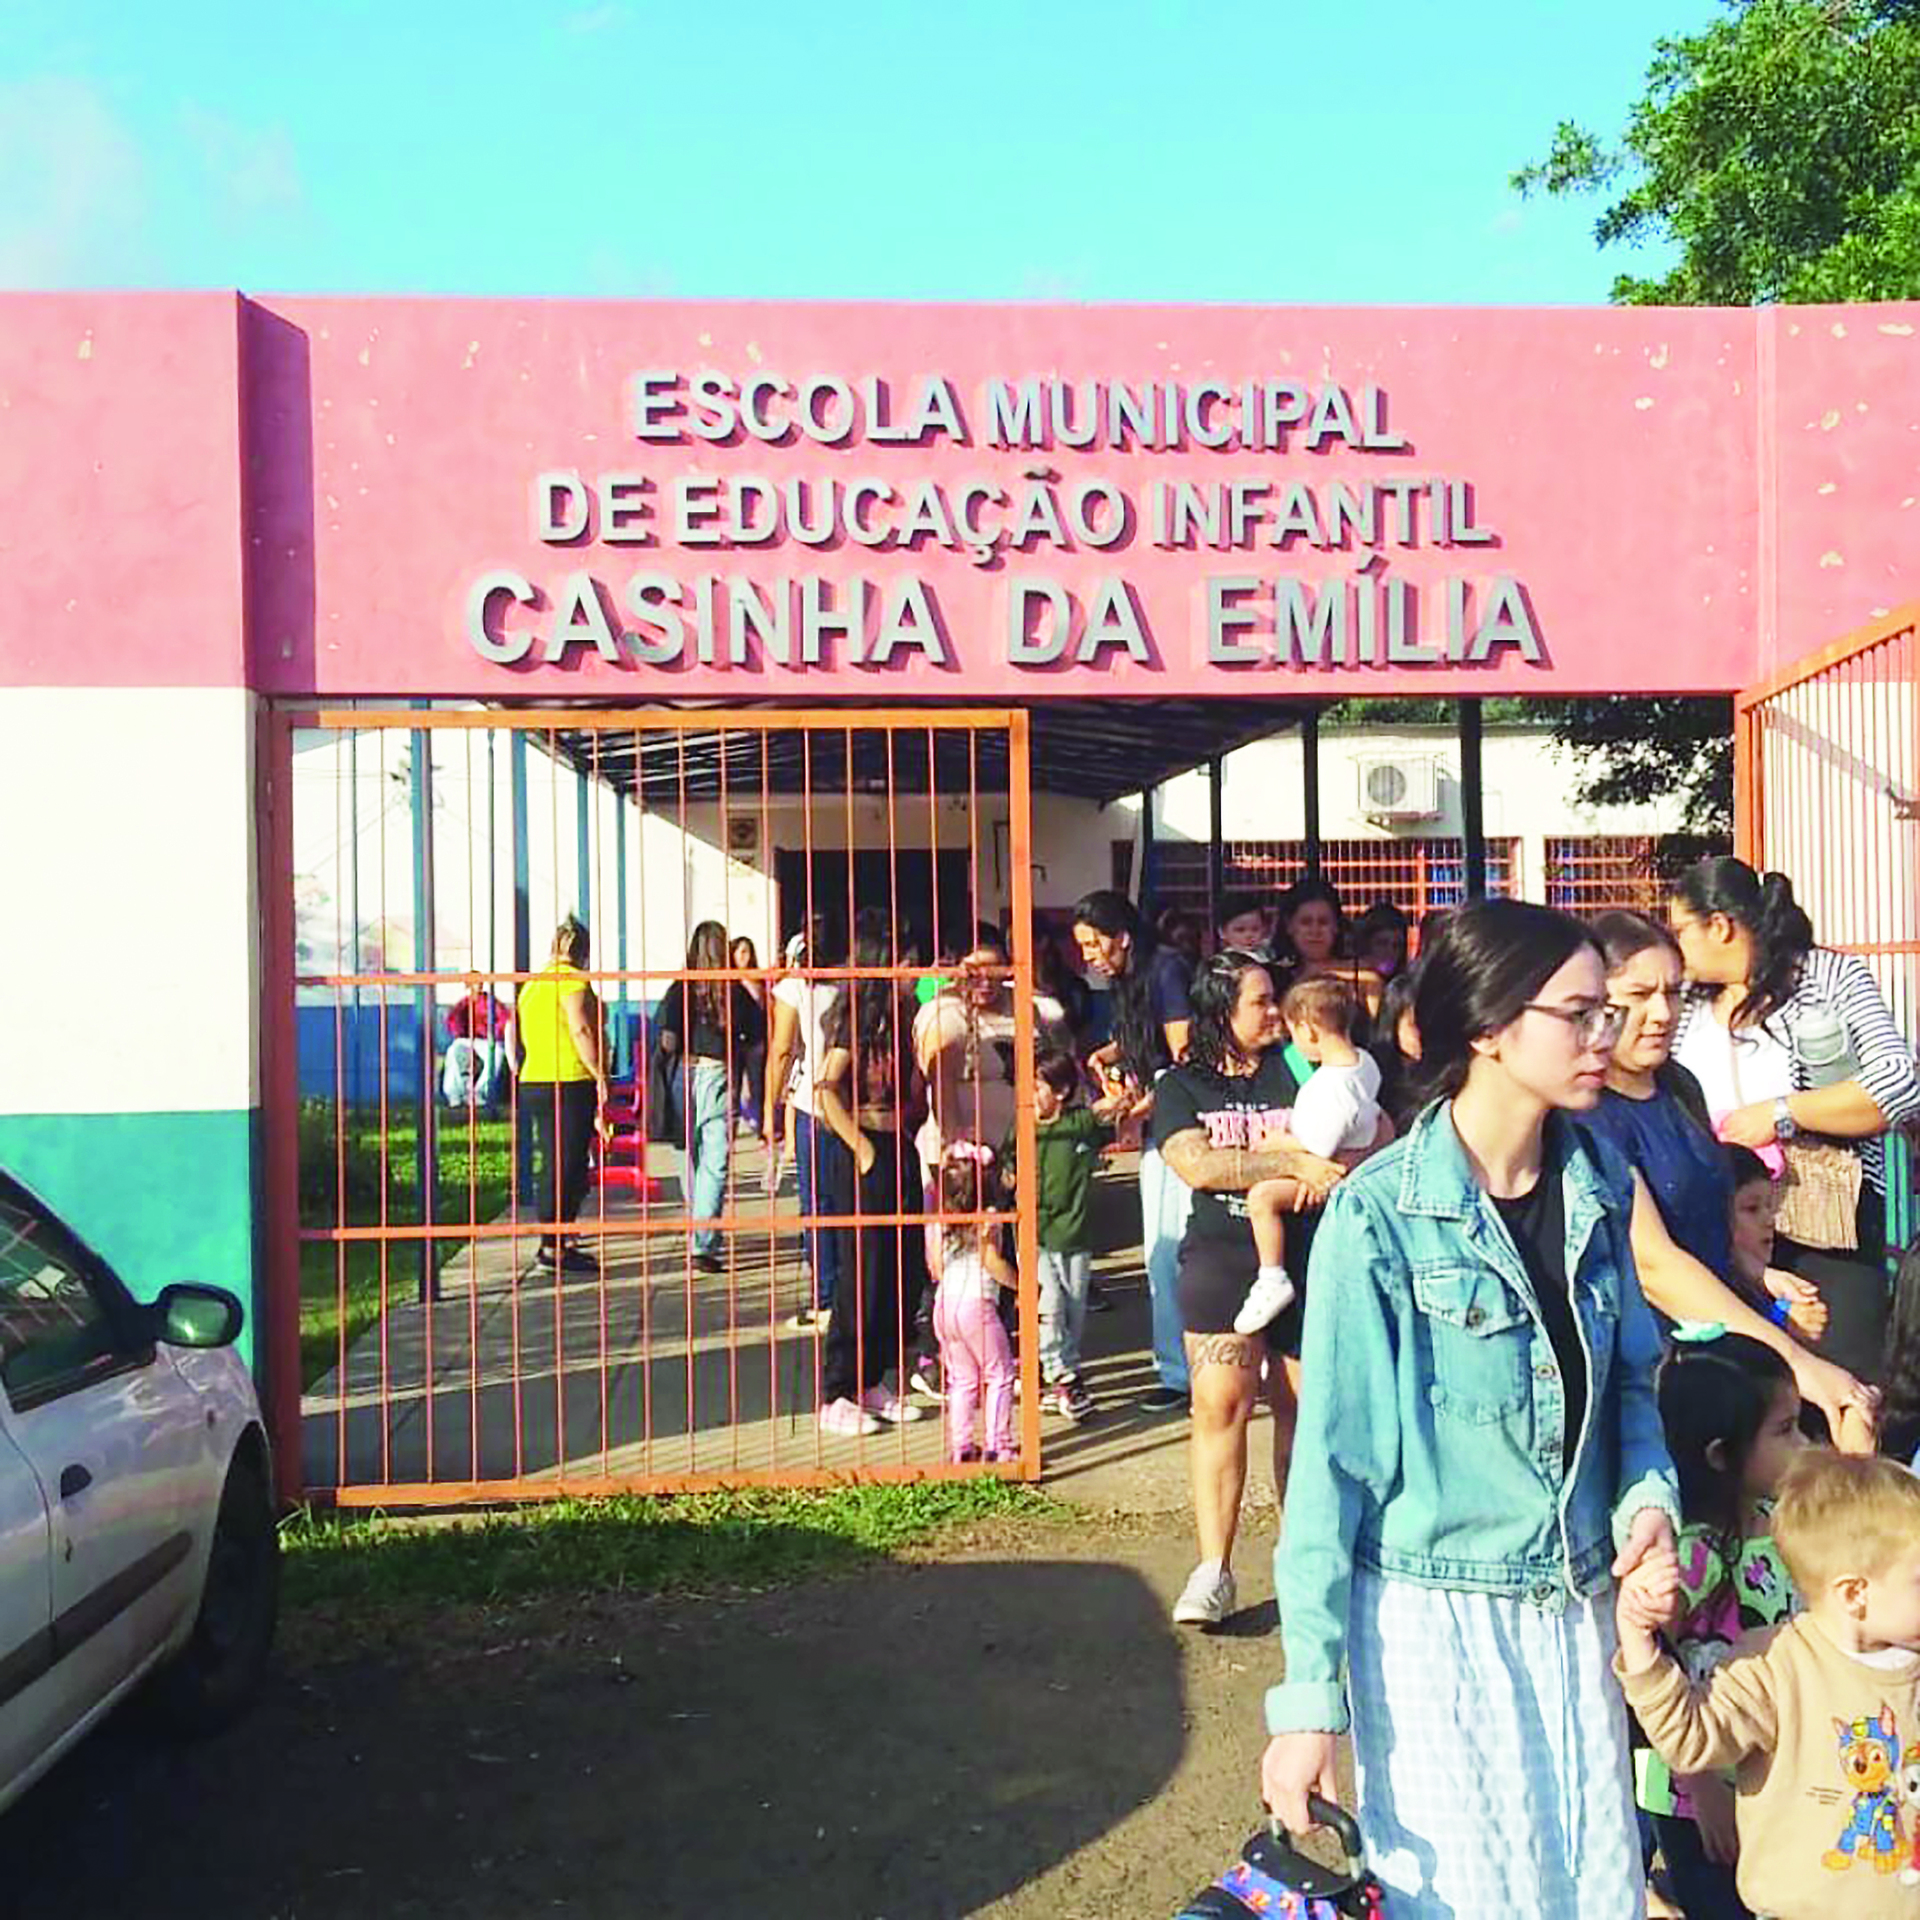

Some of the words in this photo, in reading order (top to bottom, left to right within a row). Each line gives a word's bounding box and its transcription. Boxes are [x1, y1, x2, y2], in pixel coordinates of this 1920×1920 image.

[636, 370, 968, 446] ESCOLA
[986, 380, 1412, 455] MUNICIPAL
[538, 474, 656, 547] DE
[675, 467, 1134, 566] EDUCAÇÃO
[1153, 479, 1498, 550] INFANTIL
[467, 569, 958, 671] CASINHA
[1008, 576, 1160, 671] DA
[1208, 553, 1550, 671] EMÍLIA
